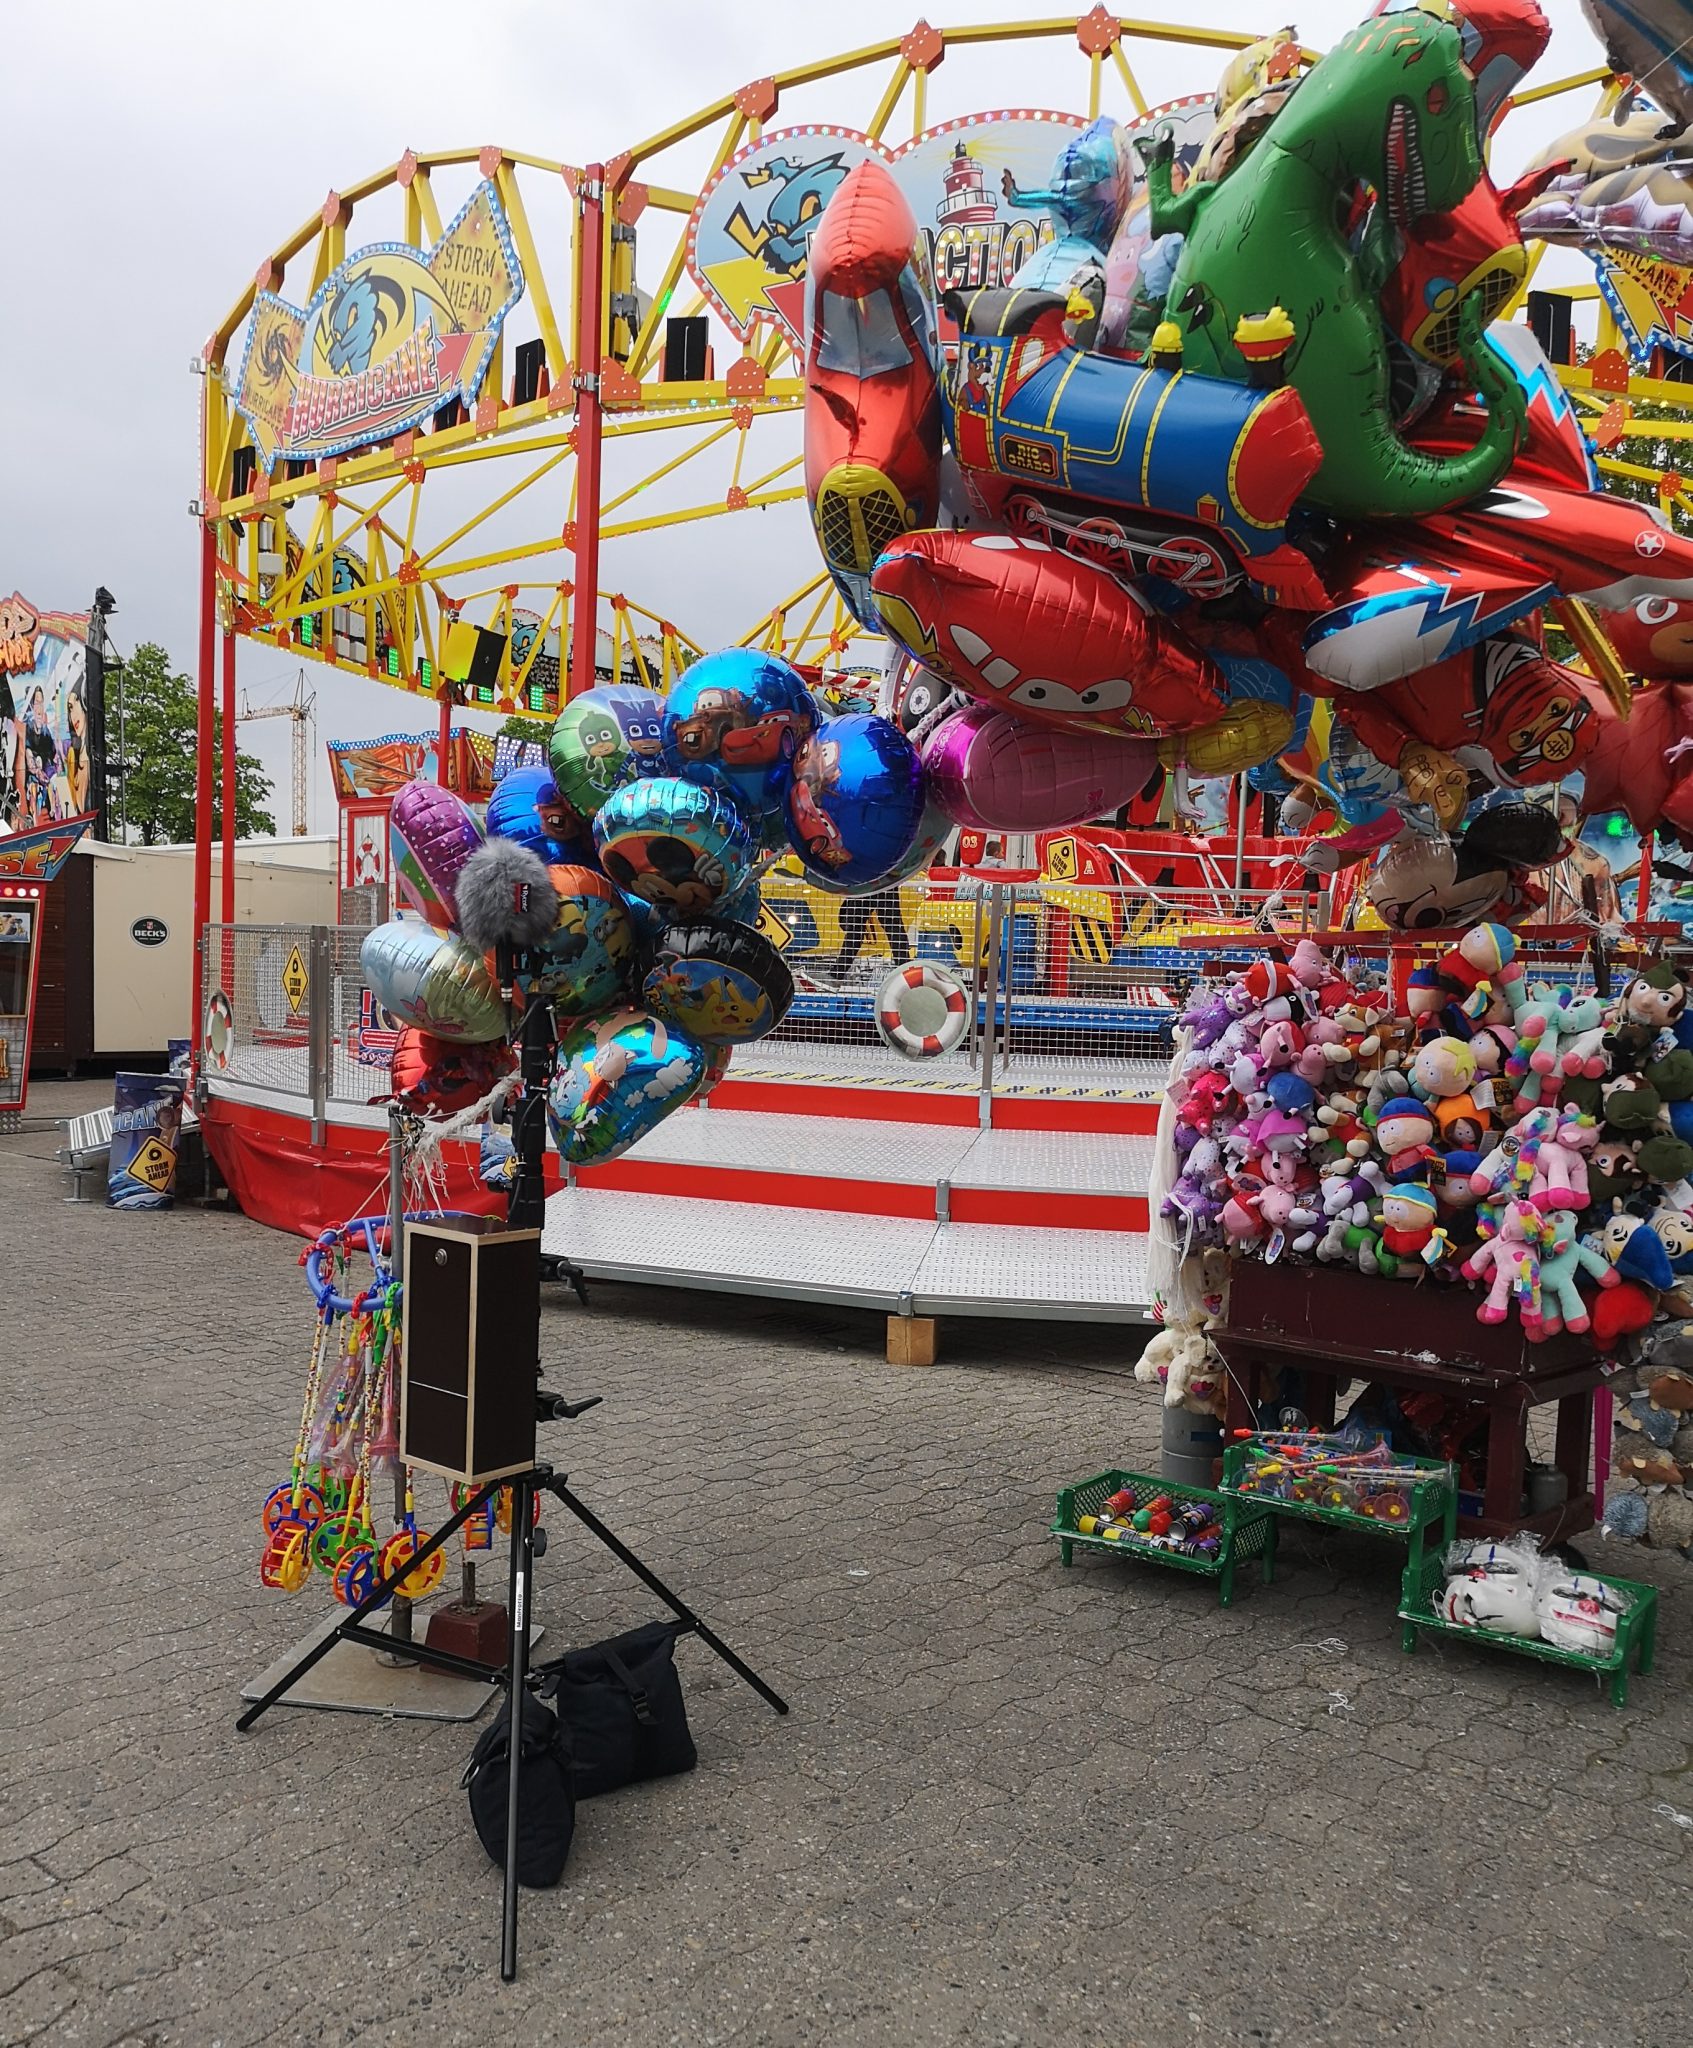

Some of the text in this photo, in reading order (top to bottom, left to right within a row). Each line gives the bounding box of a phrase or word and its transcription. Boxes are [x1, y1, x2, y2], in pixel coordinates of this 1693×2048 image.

[443, 242, 497, 279] STORM
[441, 277, 493, 315] AHEAD
[289, 316, 440, 441] HURRICANE
[962, 835, 978, 849] 03
[1083, 859, 1096, 875] A
[521, 890, 529, 912] Rycote
[134, 930, 167, 938] BECK'S
[144, 1161, 169, 1174] STORM
[148, 1169, 169, 1182] AHEAD
